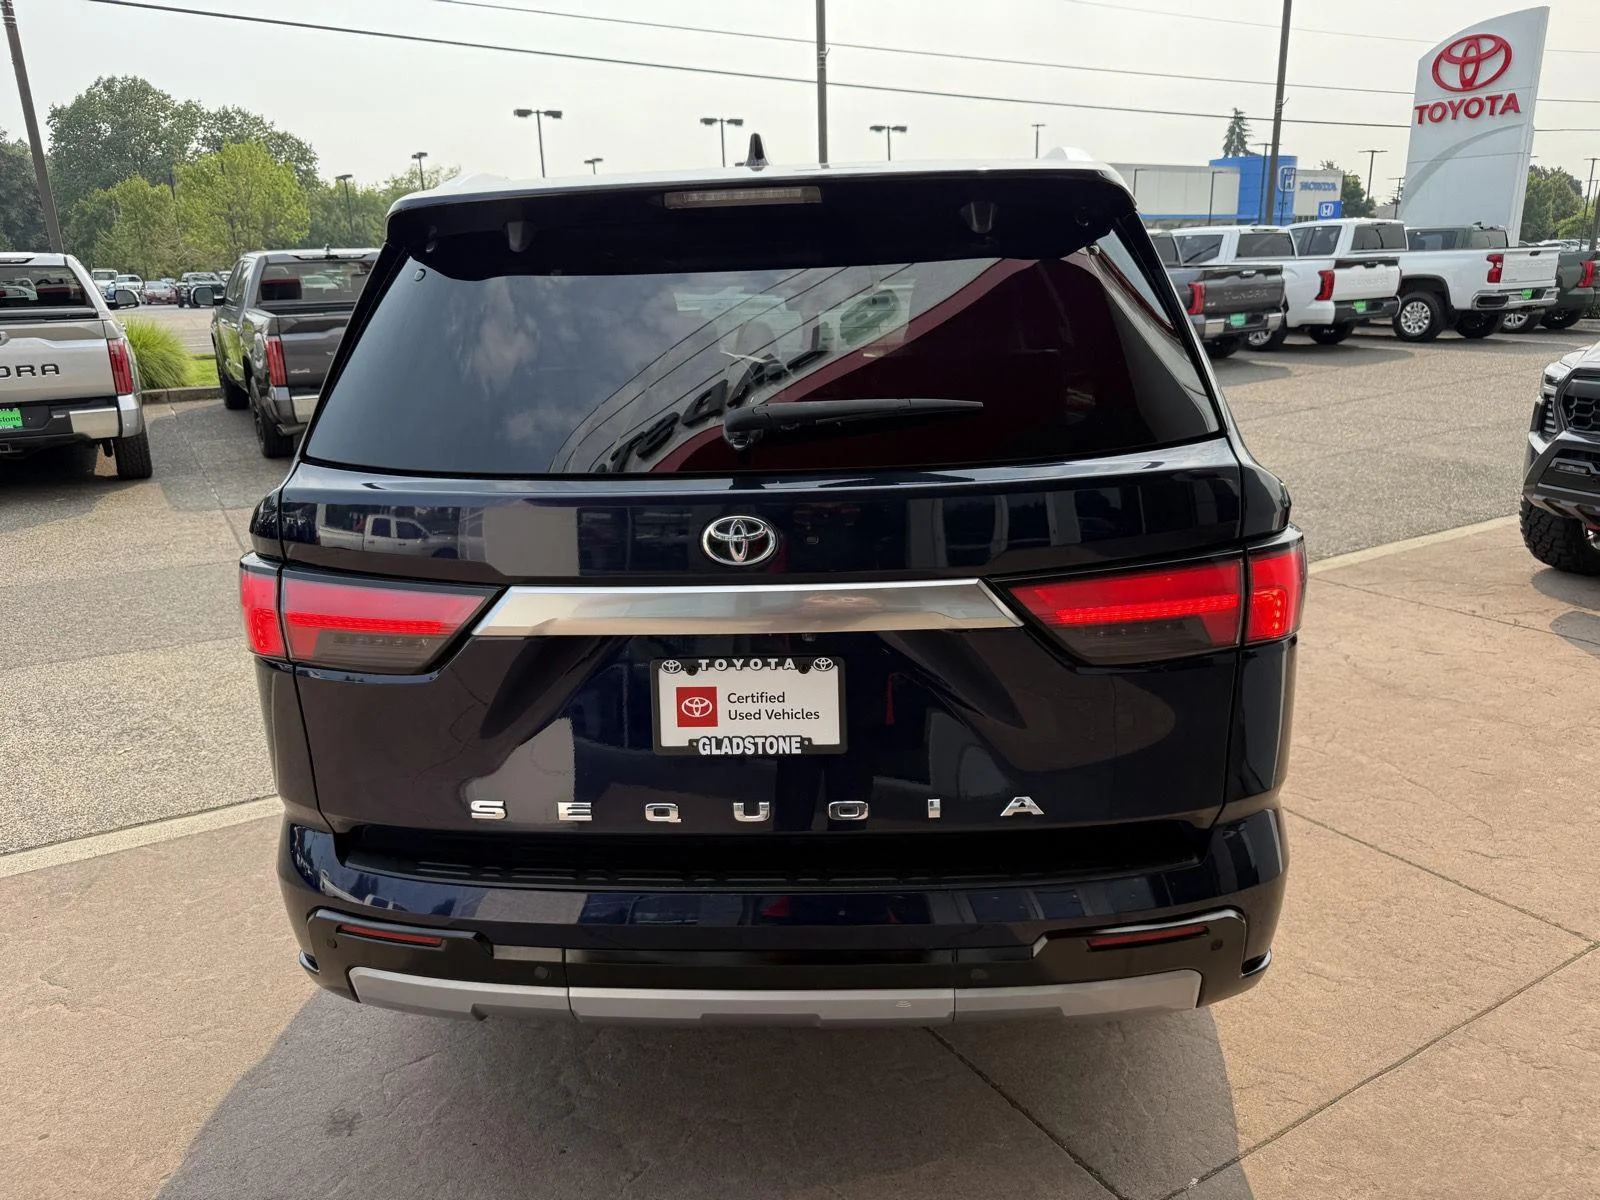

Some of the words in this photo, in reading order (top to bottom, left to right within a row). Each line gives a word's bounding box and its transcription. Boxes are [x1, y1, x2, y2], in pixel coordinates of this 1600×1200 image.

[1414, 93, 1522, 125] TOYOTA
[698, 658, 796, 671] TOYOTA
[727, 692, 786, 704] Certified
[728, 709, 762, 721] Used
[765, 708, 820, 721] Vehicles
[698, 736, 802, 755] GLADSTONE
[470, 796, 1045, 822] SEQUOIA
